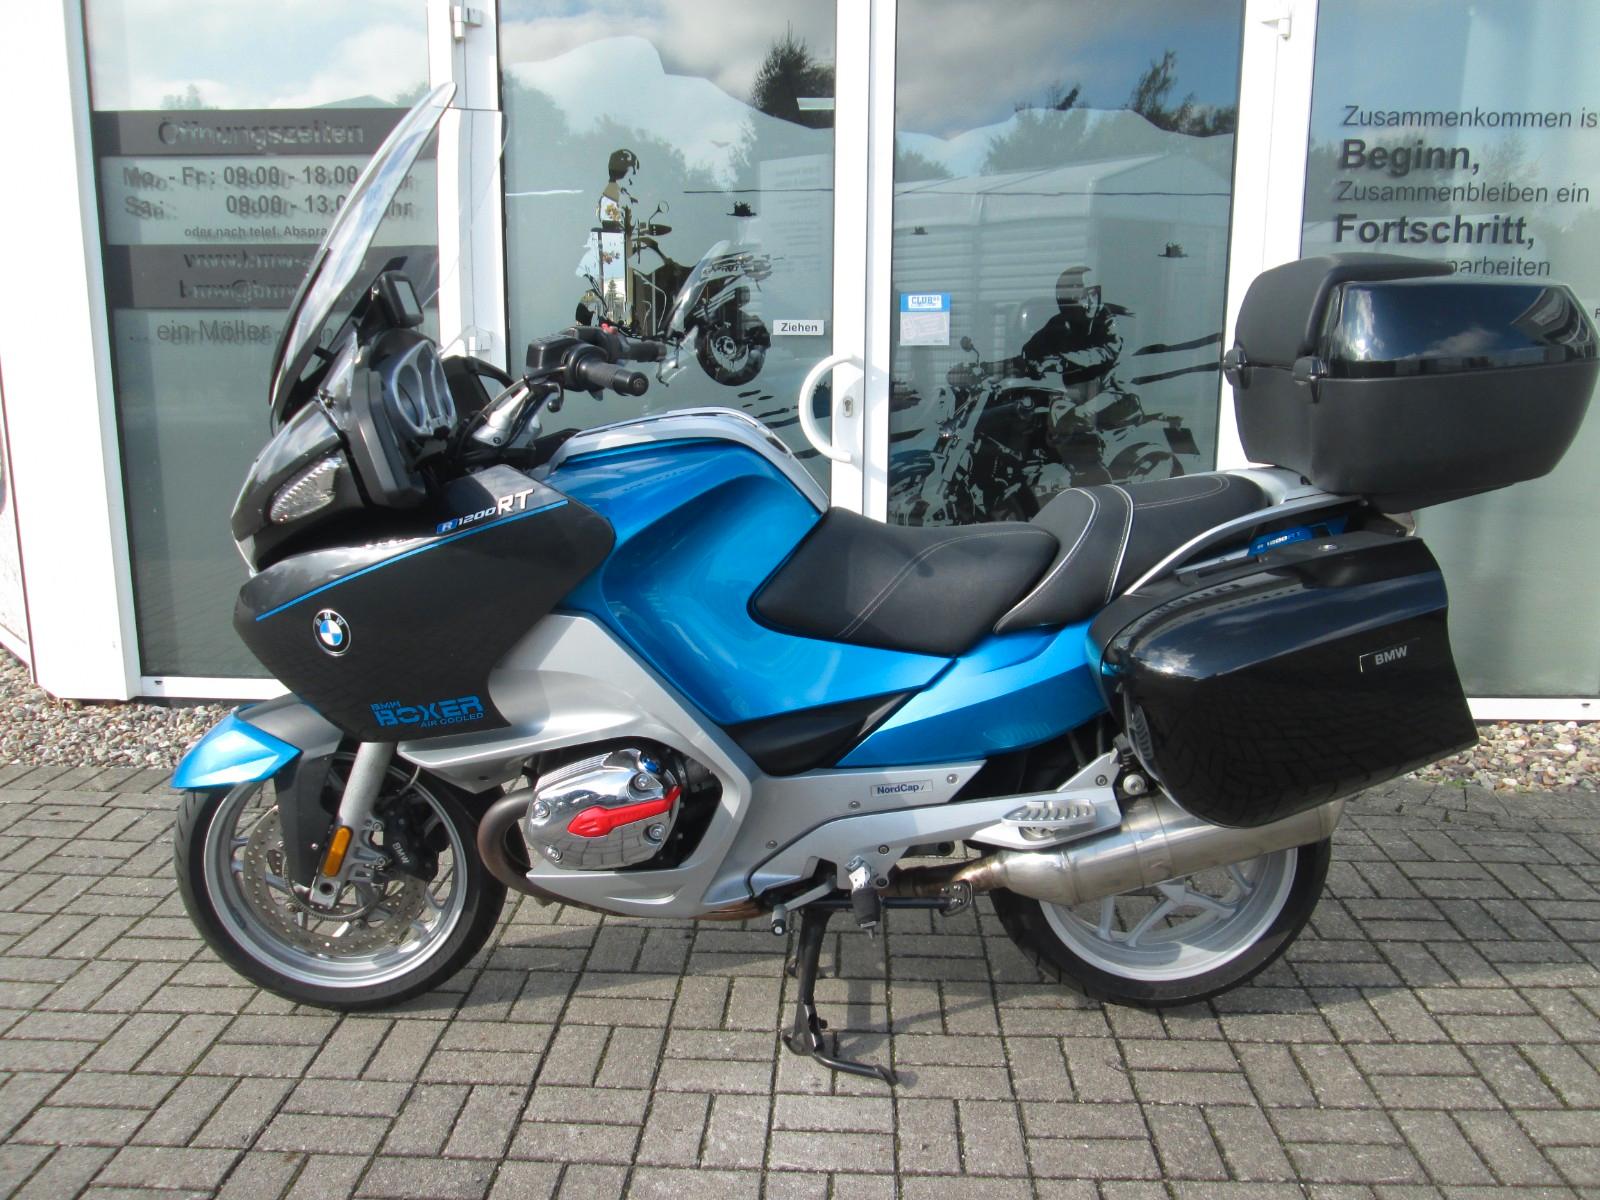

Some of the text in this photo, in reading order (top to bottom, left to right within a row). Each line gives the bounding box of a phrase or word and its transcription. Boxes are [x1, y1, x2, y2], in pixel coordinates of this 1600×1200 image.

[1343, 104, 1600, 128] Zusammenkommen is
[1341, 139, 1480, 176] Beginn,
[302, 165, 359, 185] 18.00
[1337, 181, 1590, 203] Zusammenbleiben ein
[304, 194, 347, 214] 13.0
[216, 226, 246, 238] nach
[284, 225, 327, 240] Abspra
[1335, 213, 1535, 249] Fortschritt,
[1446, 256, 1551, 277] narbeiten
[780, 321, 818, 333] Ziehen
[1374, 645, 1408, 667] BMW
[374, 695, 485, 728] BOXER
[440, 712, 484, 726] COOLED
[877, 783, 920, 795] NordCap
[391, 841, 411, 865] BMW
